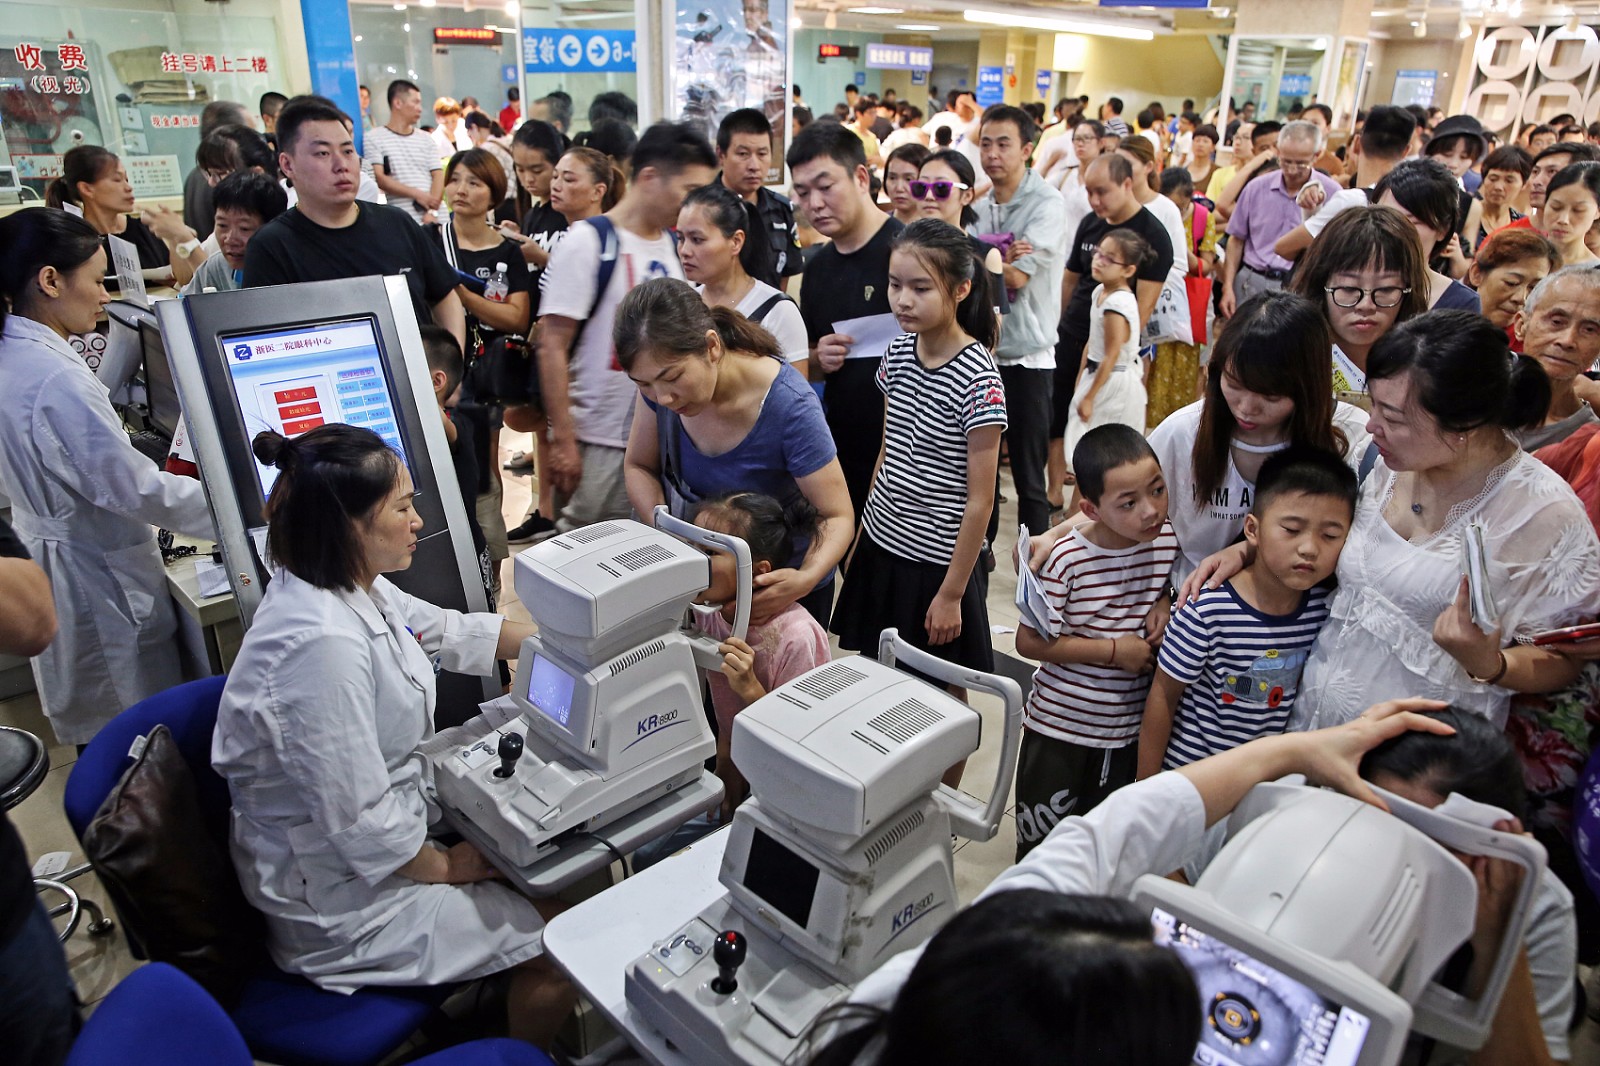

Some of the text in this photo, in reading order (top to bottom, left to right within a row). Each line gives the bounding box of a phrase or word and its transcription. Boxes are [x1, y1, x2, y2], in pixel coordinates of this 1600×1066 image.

[15, 43, 89, 71] 收费
[160, 52, 269, 73] 挂号请上二楼
[255, 337, 332, 355] 浙医二院眼科中心
